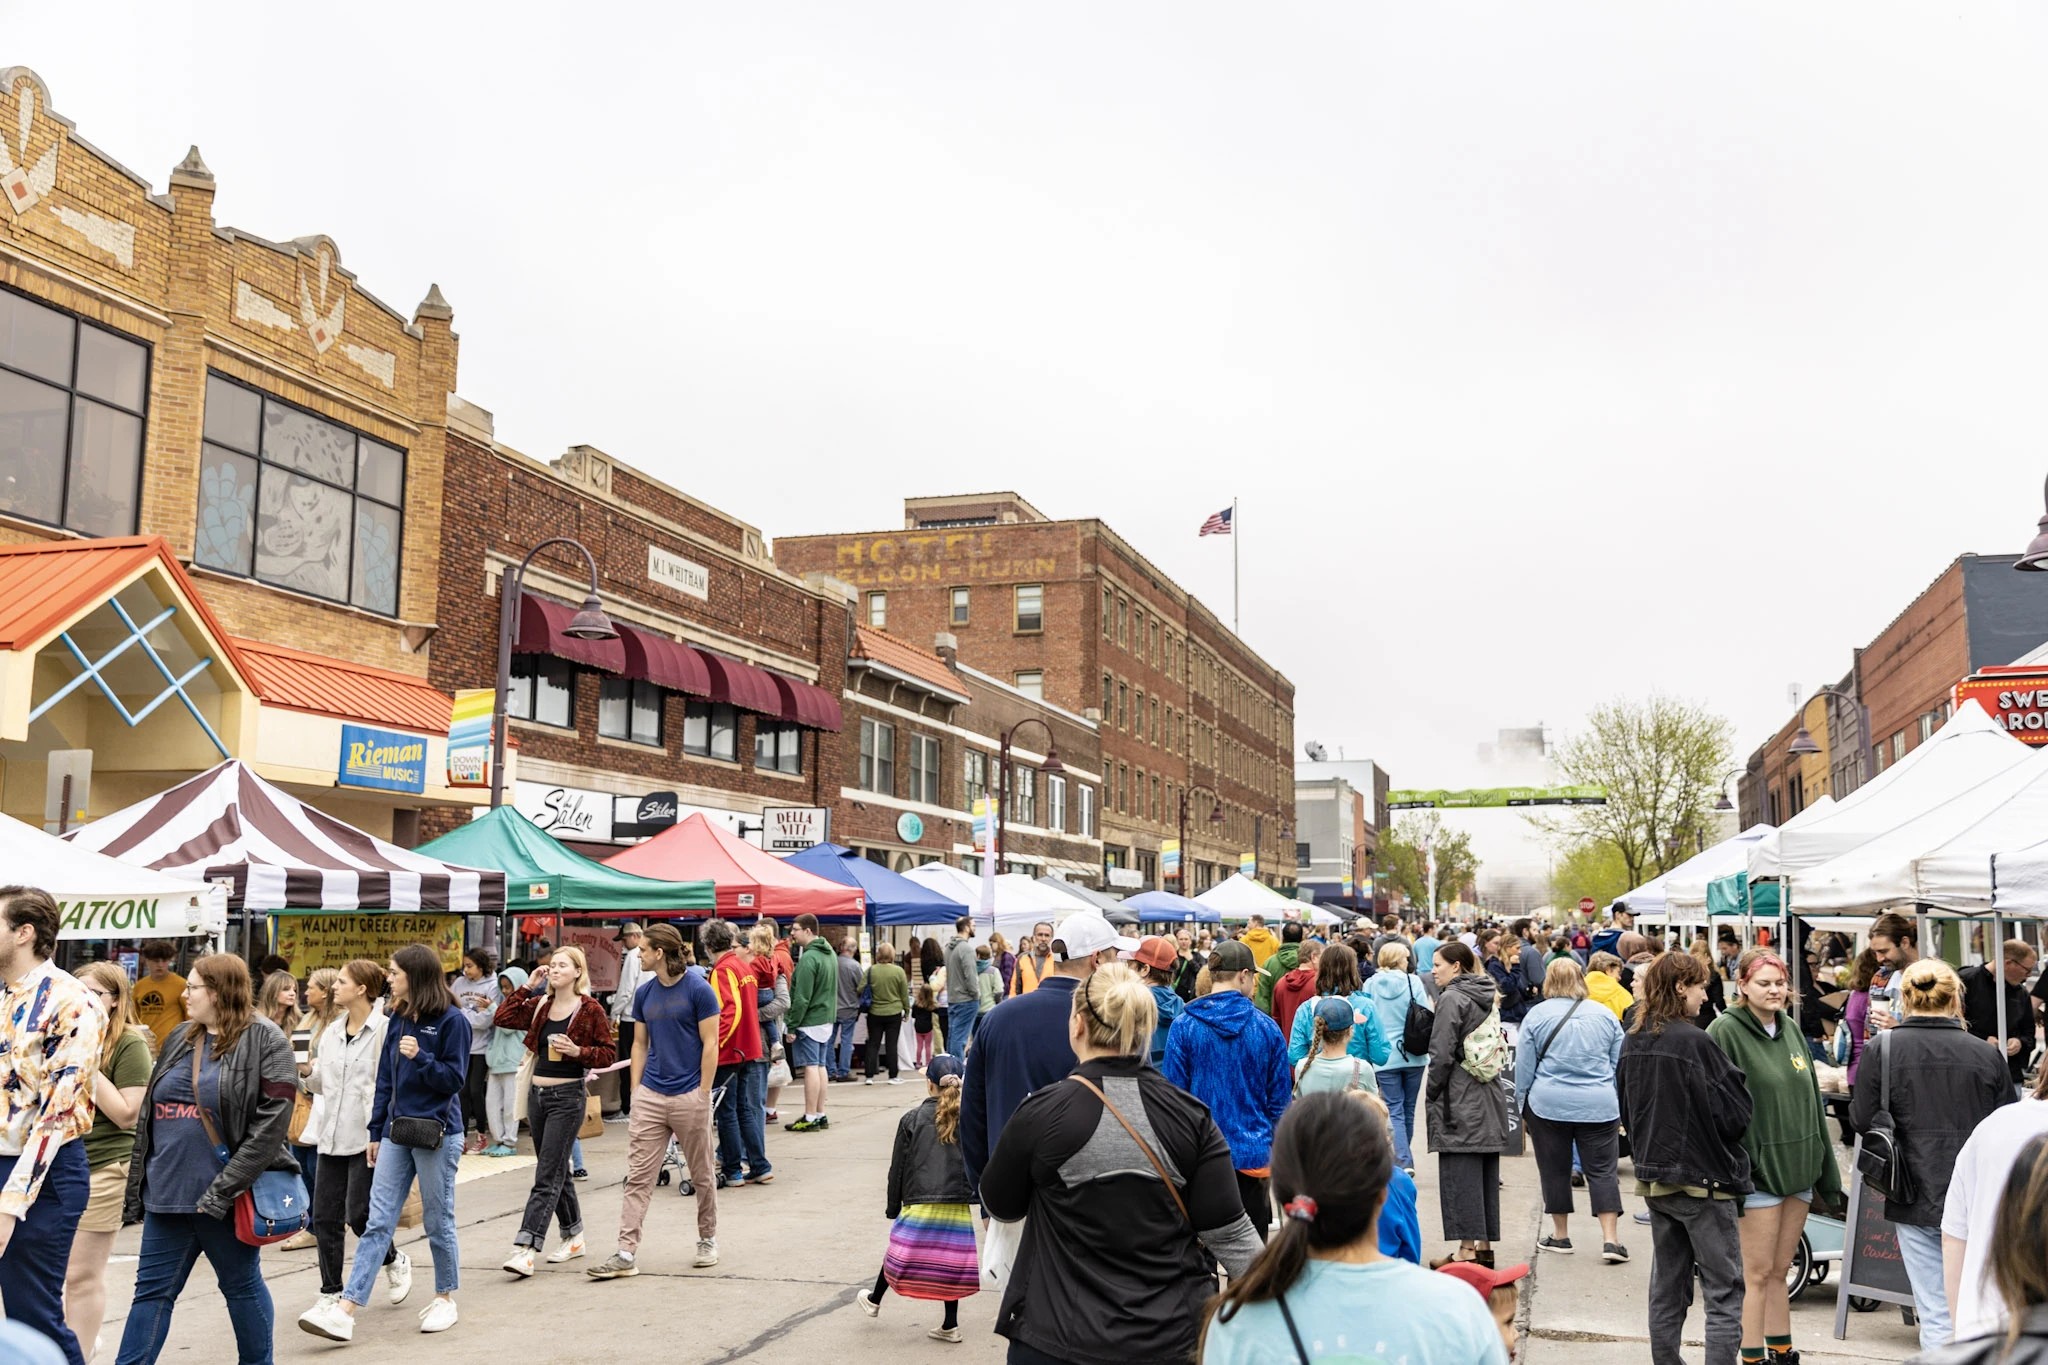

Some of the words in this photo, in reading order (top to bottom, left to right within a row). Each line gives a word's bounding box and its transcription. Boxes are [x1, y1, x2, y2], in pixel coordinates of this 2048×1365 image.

[799, 561, 941, 585] ELDON
[1993, 711, 2048, 731] ARO
[348, 739, 424, 769] Rieman
[452, 755, 482, 765] DOWN
[382, 765, 415, 783] MUSIC
[453, 763, 482, 773] TOWN
[454, 772, 481, 781] AMES
[532, 788, 593, 830] Salon
[777, 811, 812, 824] DELLA
[782, 823, 806, 836] VITI
[1580, 901, 1595, 909] STOP
[57, 898, 159, 930] ATION
[301, 917, 356, 934] WALNUT
[359, 917, 399, 933] CREEK
[402, 917, 436, 933] FARM
[322, 936, 341, 947] local
[343, 936, 368, 949] honey
[572, 932, 597, 949] Country
